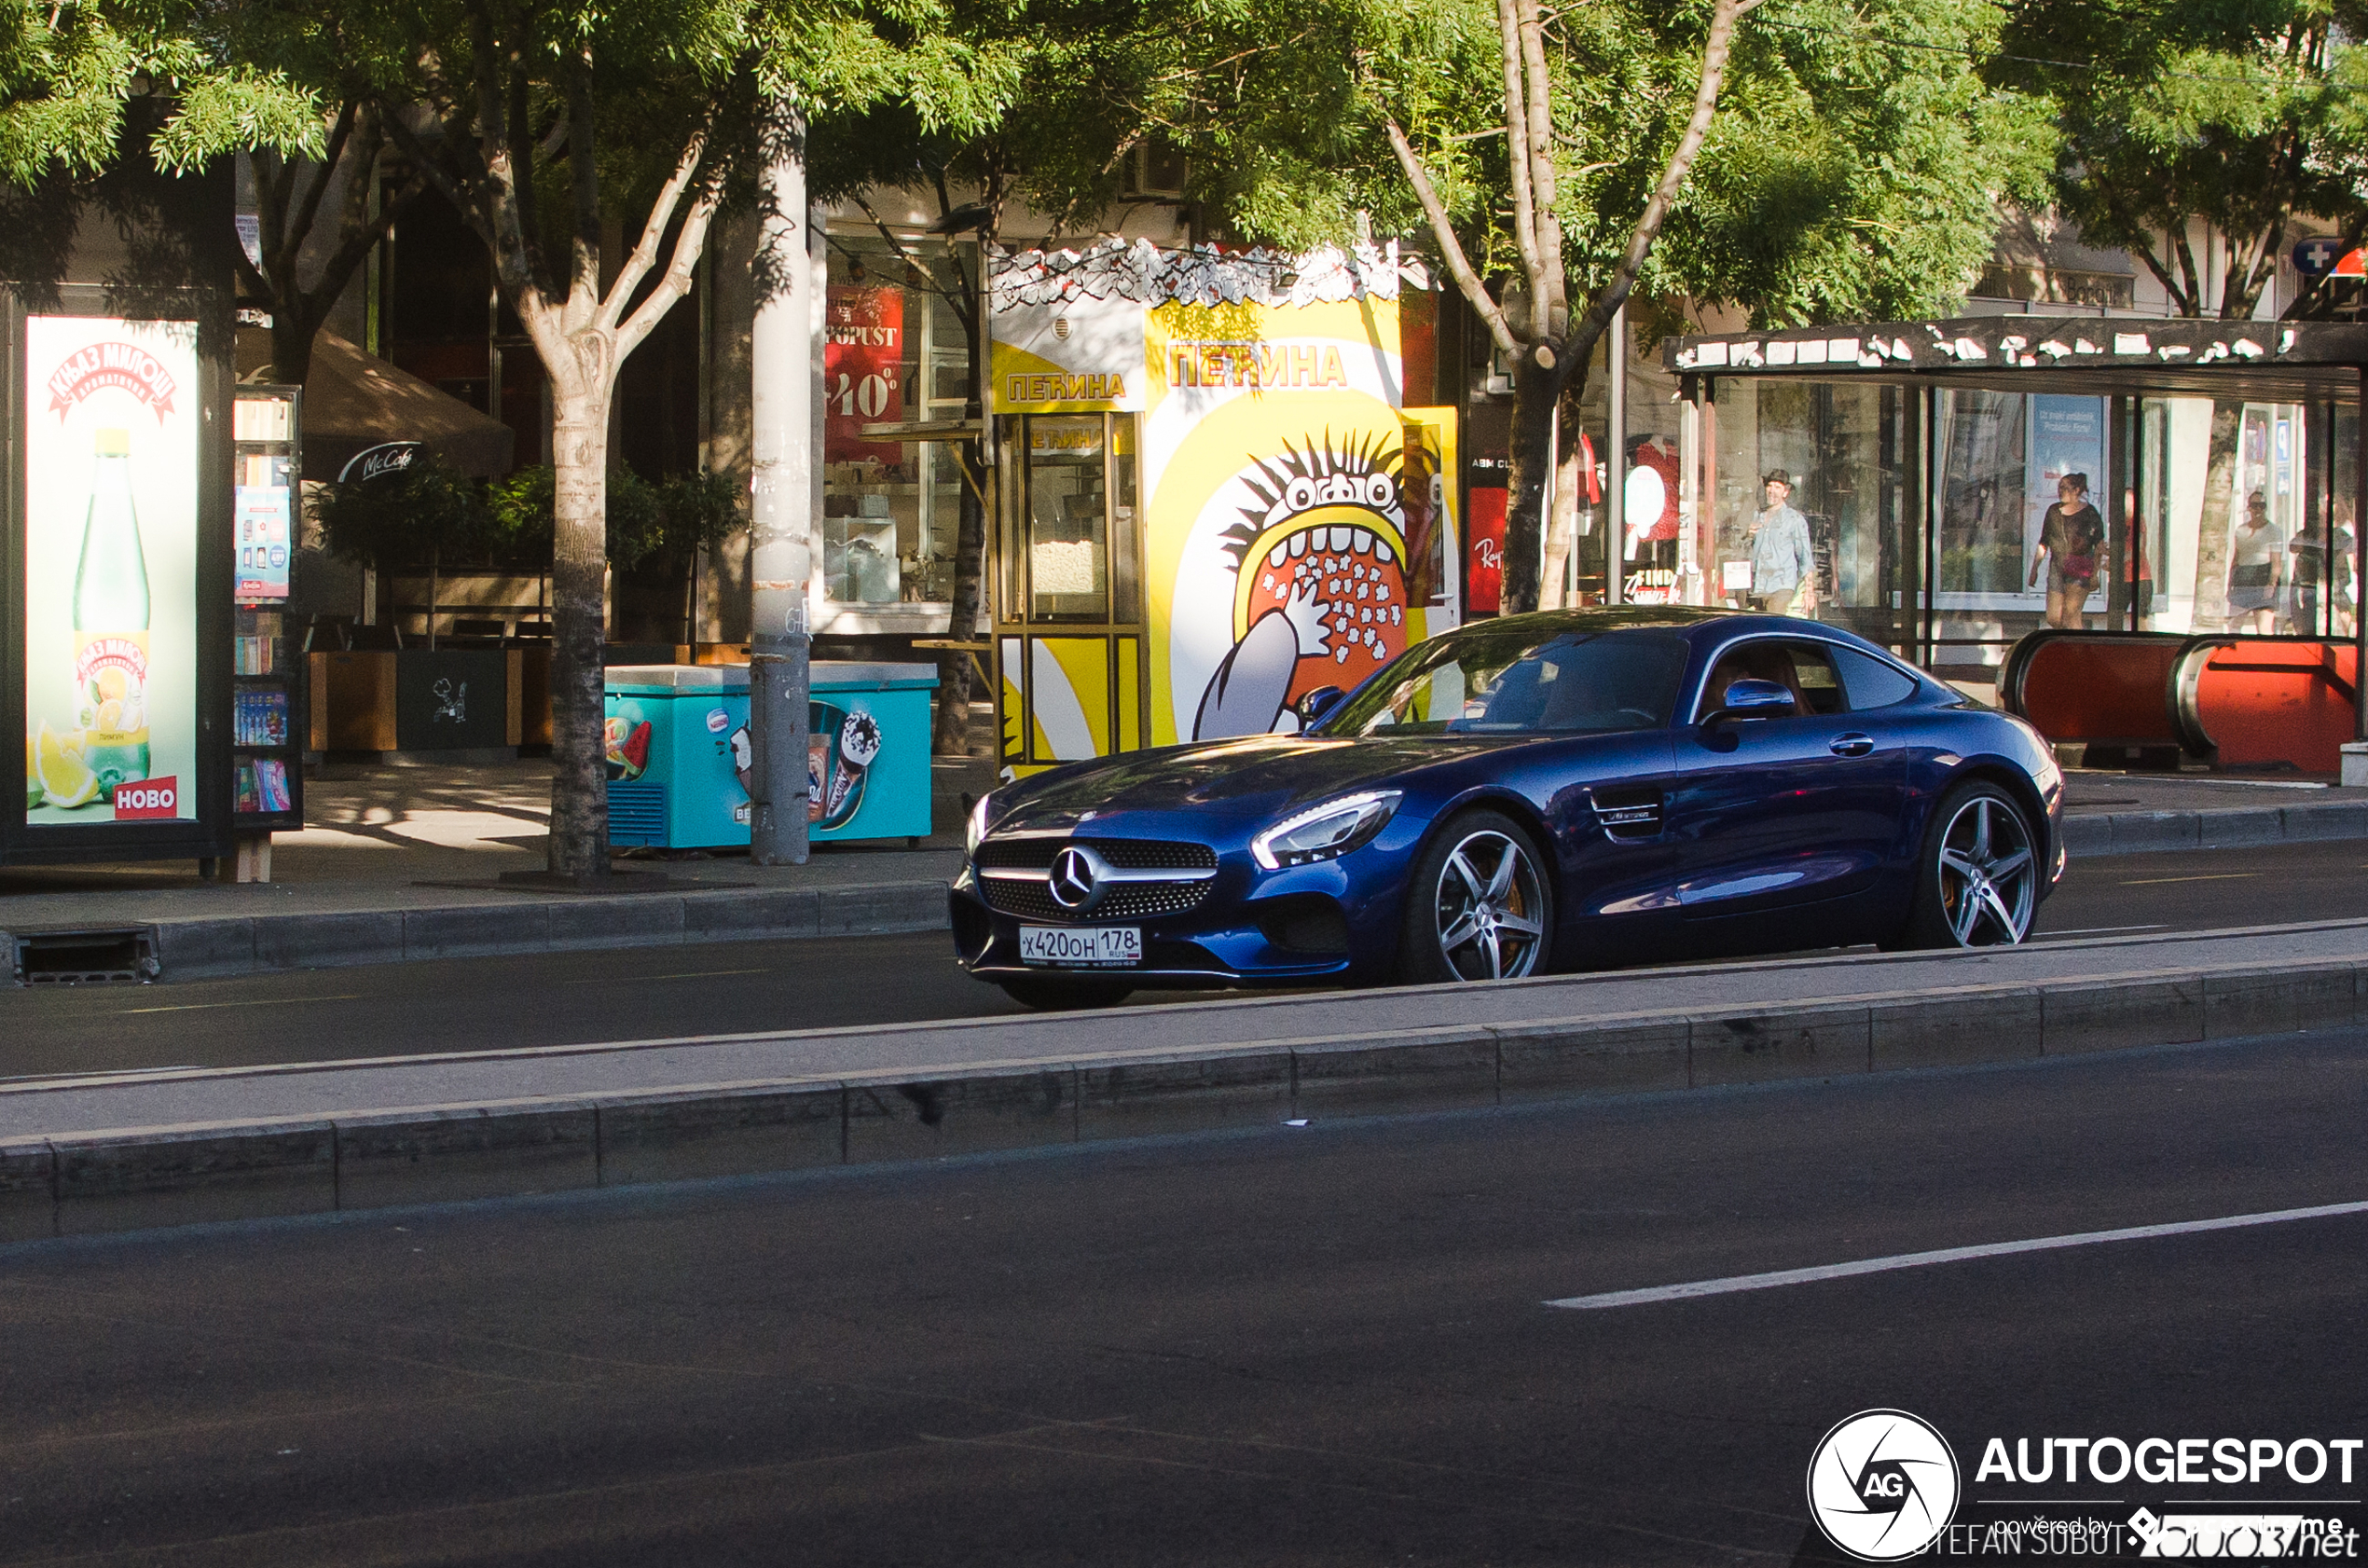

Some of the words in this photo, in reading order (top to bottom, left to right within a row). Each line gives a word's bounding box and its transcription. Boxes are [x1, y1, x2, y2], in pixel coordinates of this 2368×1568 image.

[49, 346, 102, 399] КЊАЗ
[103, 343, 174, 399] МИЛОШ
[1169, 342, 1347, 388] ПЕЋИНА
[1008, 373, 1126, 402] ПЕЋИНА
[105, 639, 146, 673] МИЛОШ
[117, 789, 175, 809] НОВО
[1100, 930, 1135, 950] 178
[1108, 950, 1127, 958] RUS
